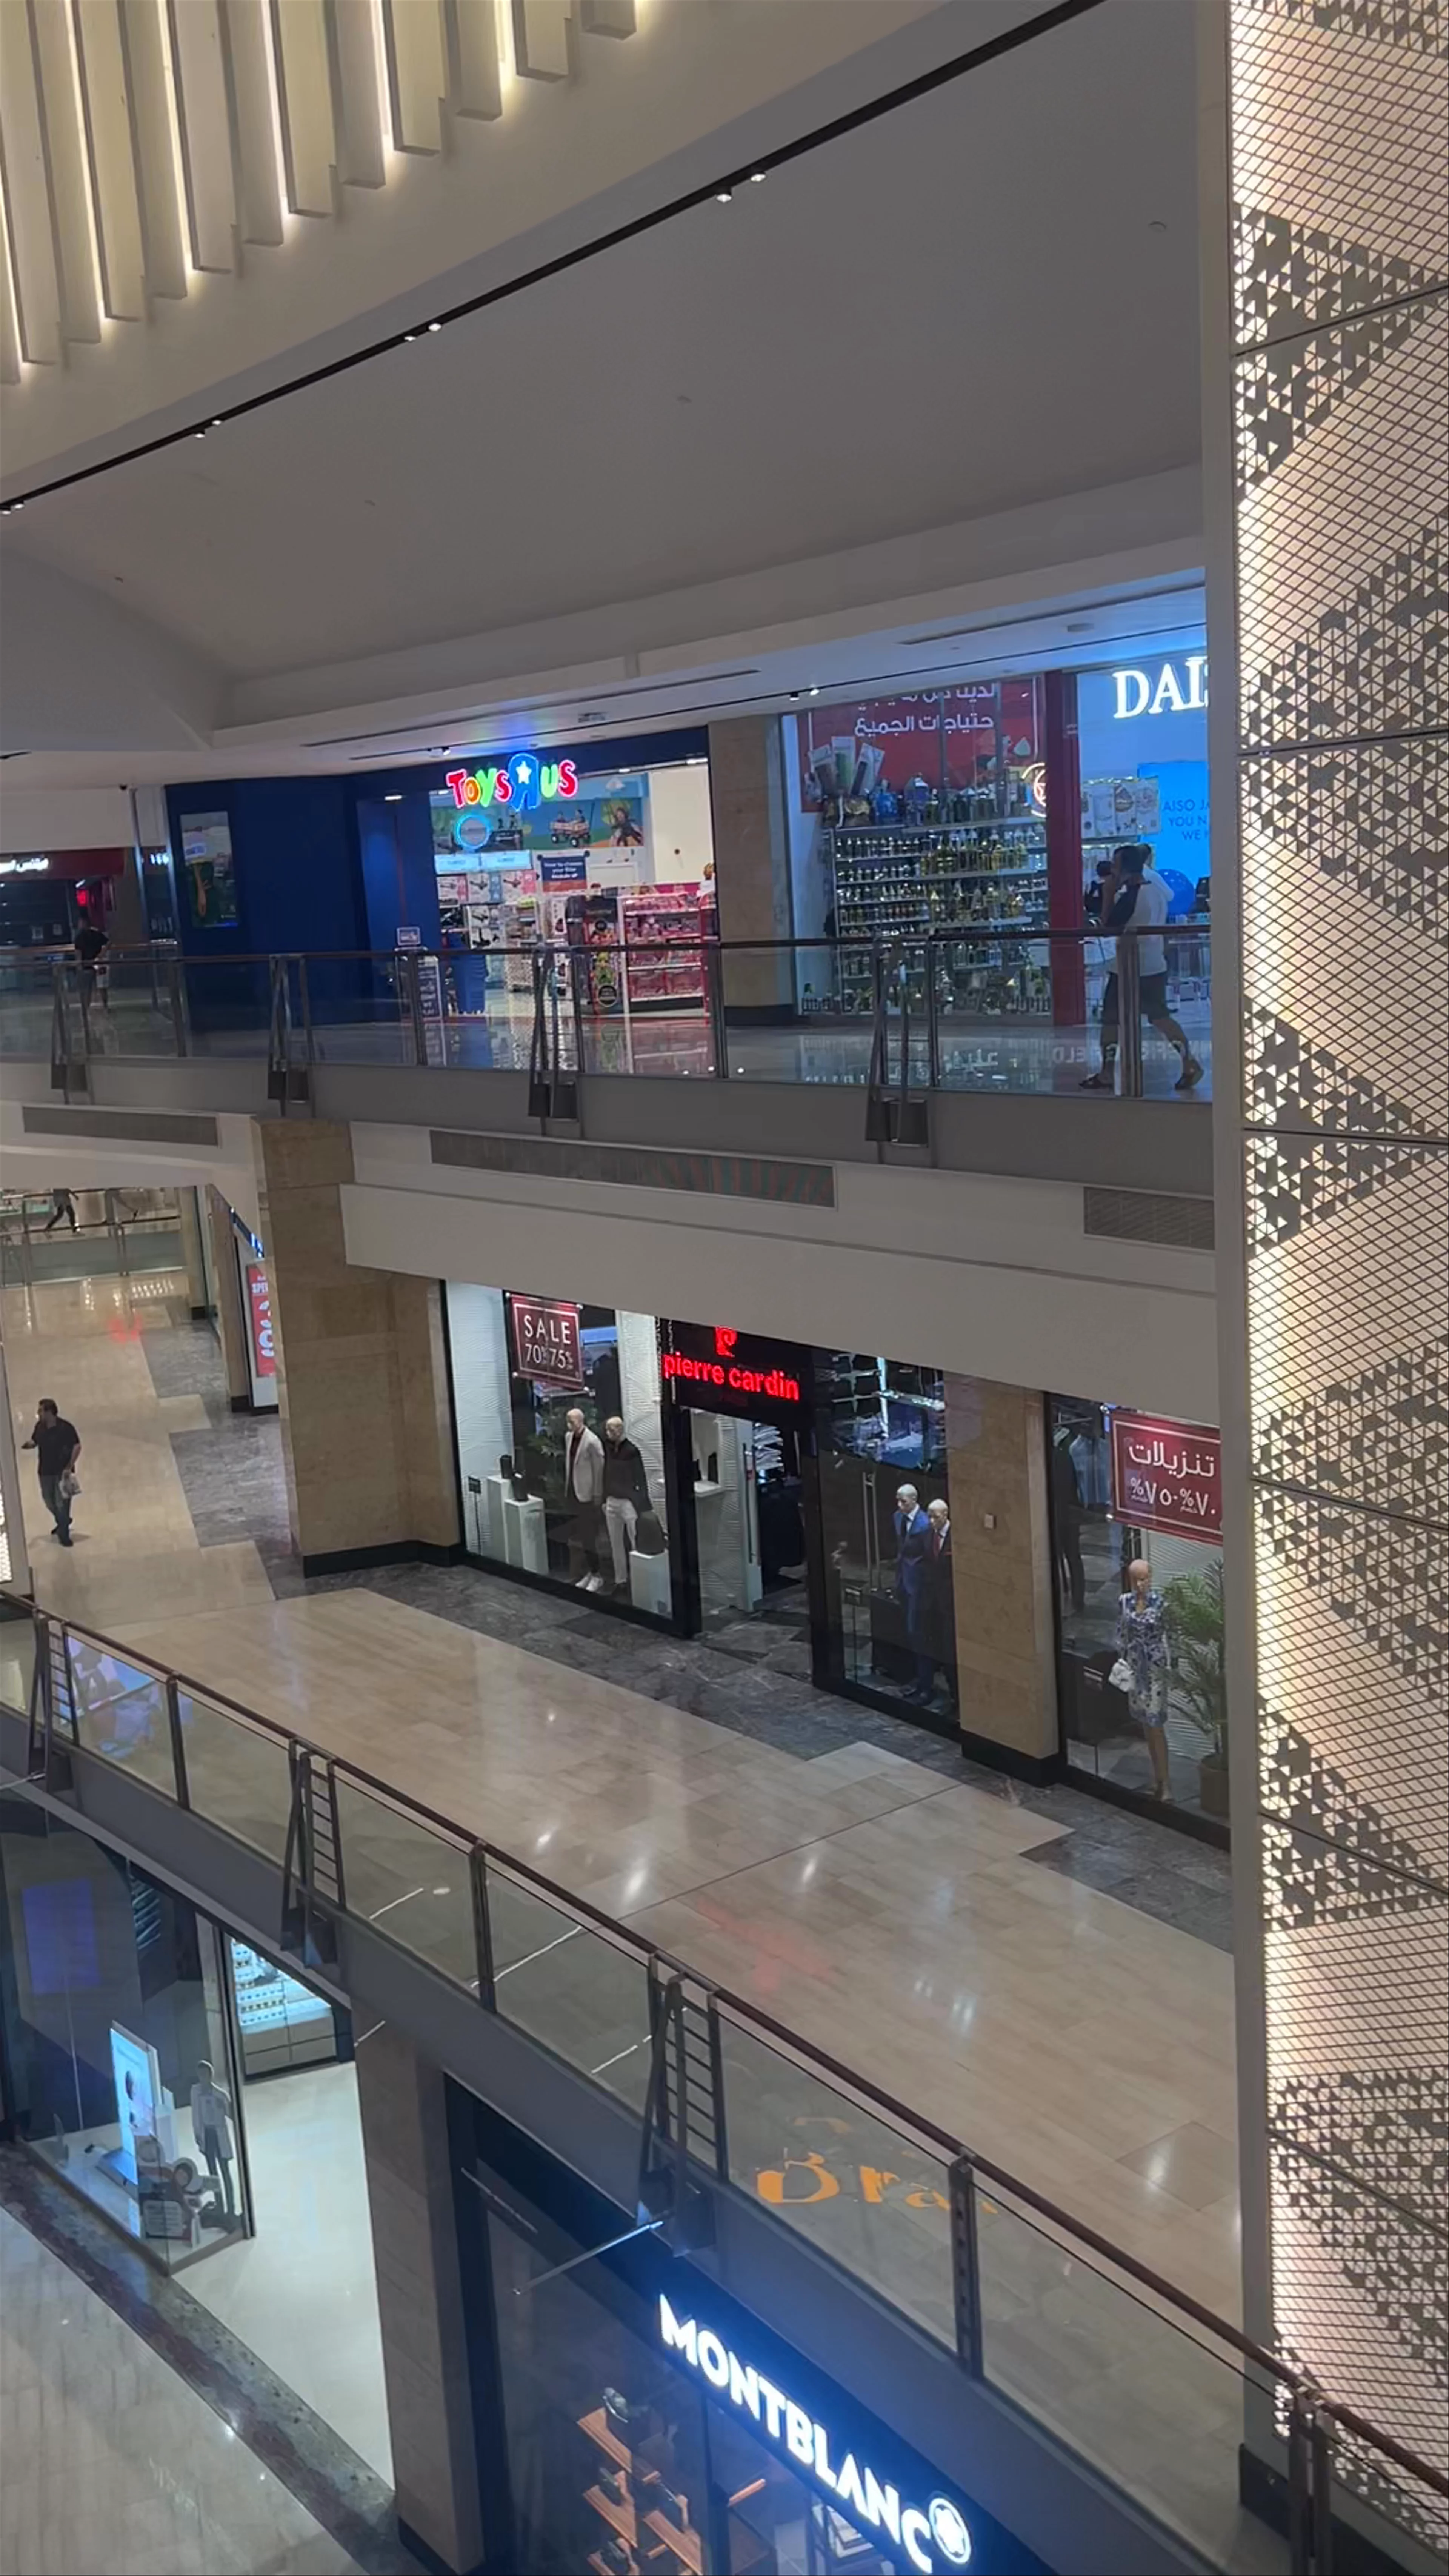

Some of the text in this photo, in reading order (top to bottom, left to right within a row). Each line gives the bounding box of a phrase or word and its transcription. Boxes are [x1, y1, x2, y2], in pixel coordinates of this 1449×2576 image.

[1112, 655, 1208, 719] DAI
[855, 716, 914, 736] الجميع
[1169, 816, 1194, 827] YOU
[1181, 830, 1201, 840] WE
[524, 1315, 571, 1344] SALE
[663, 1352, 799, 1401] pierre cardin
[1129, 1441, 1214, 1479] تنزيلات
[660, 2293, 932, 2573] MONTBLANC
